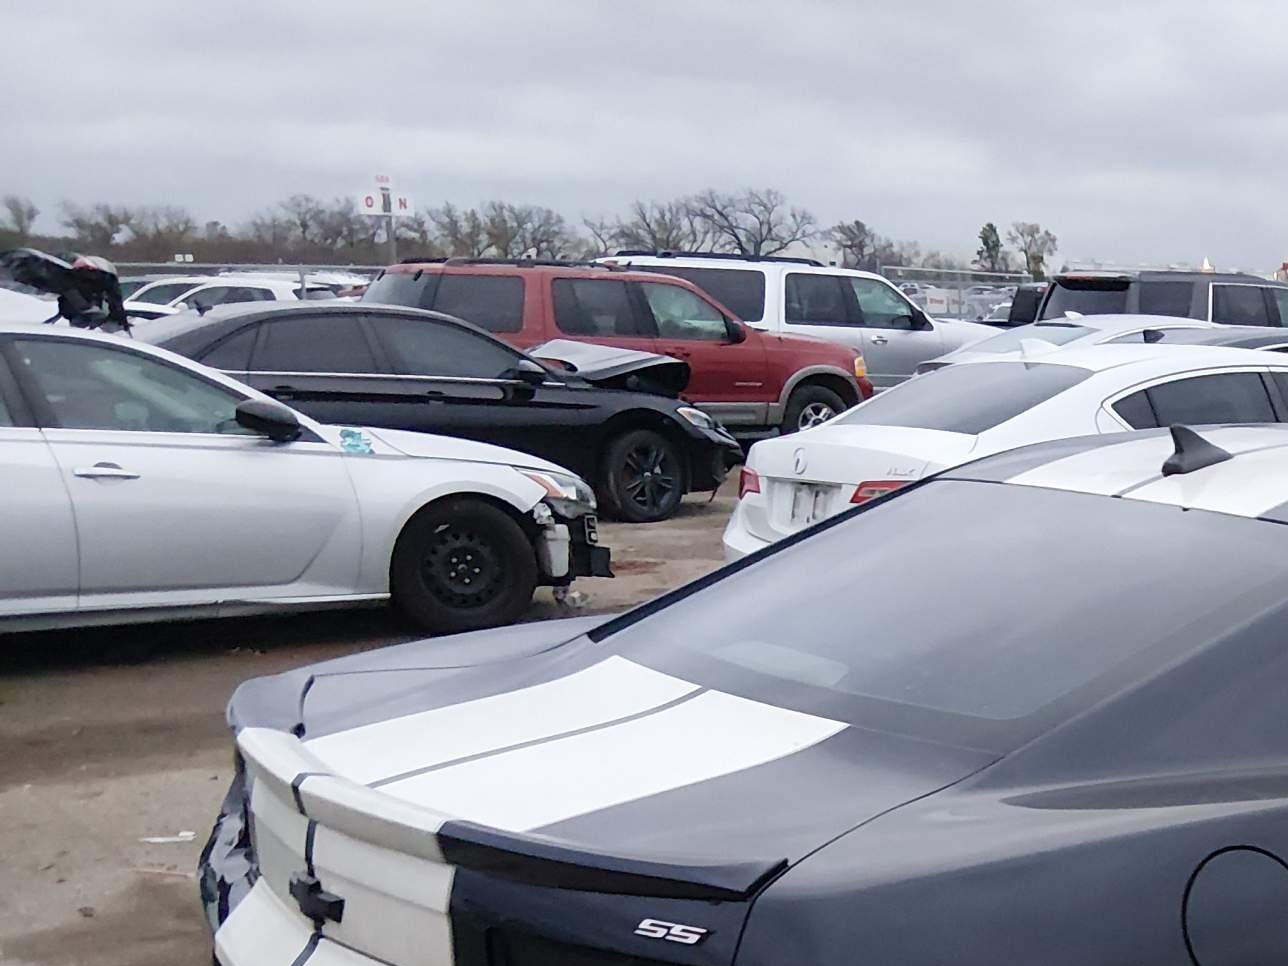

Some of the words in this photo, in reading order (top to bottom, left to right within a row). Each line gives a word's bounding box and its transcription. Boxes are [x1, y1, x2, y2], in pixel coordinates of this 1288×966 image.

[364, 195, 374, 208] O
[398, 197, 408, 210] N
[633, 918, 708, 945] SS
